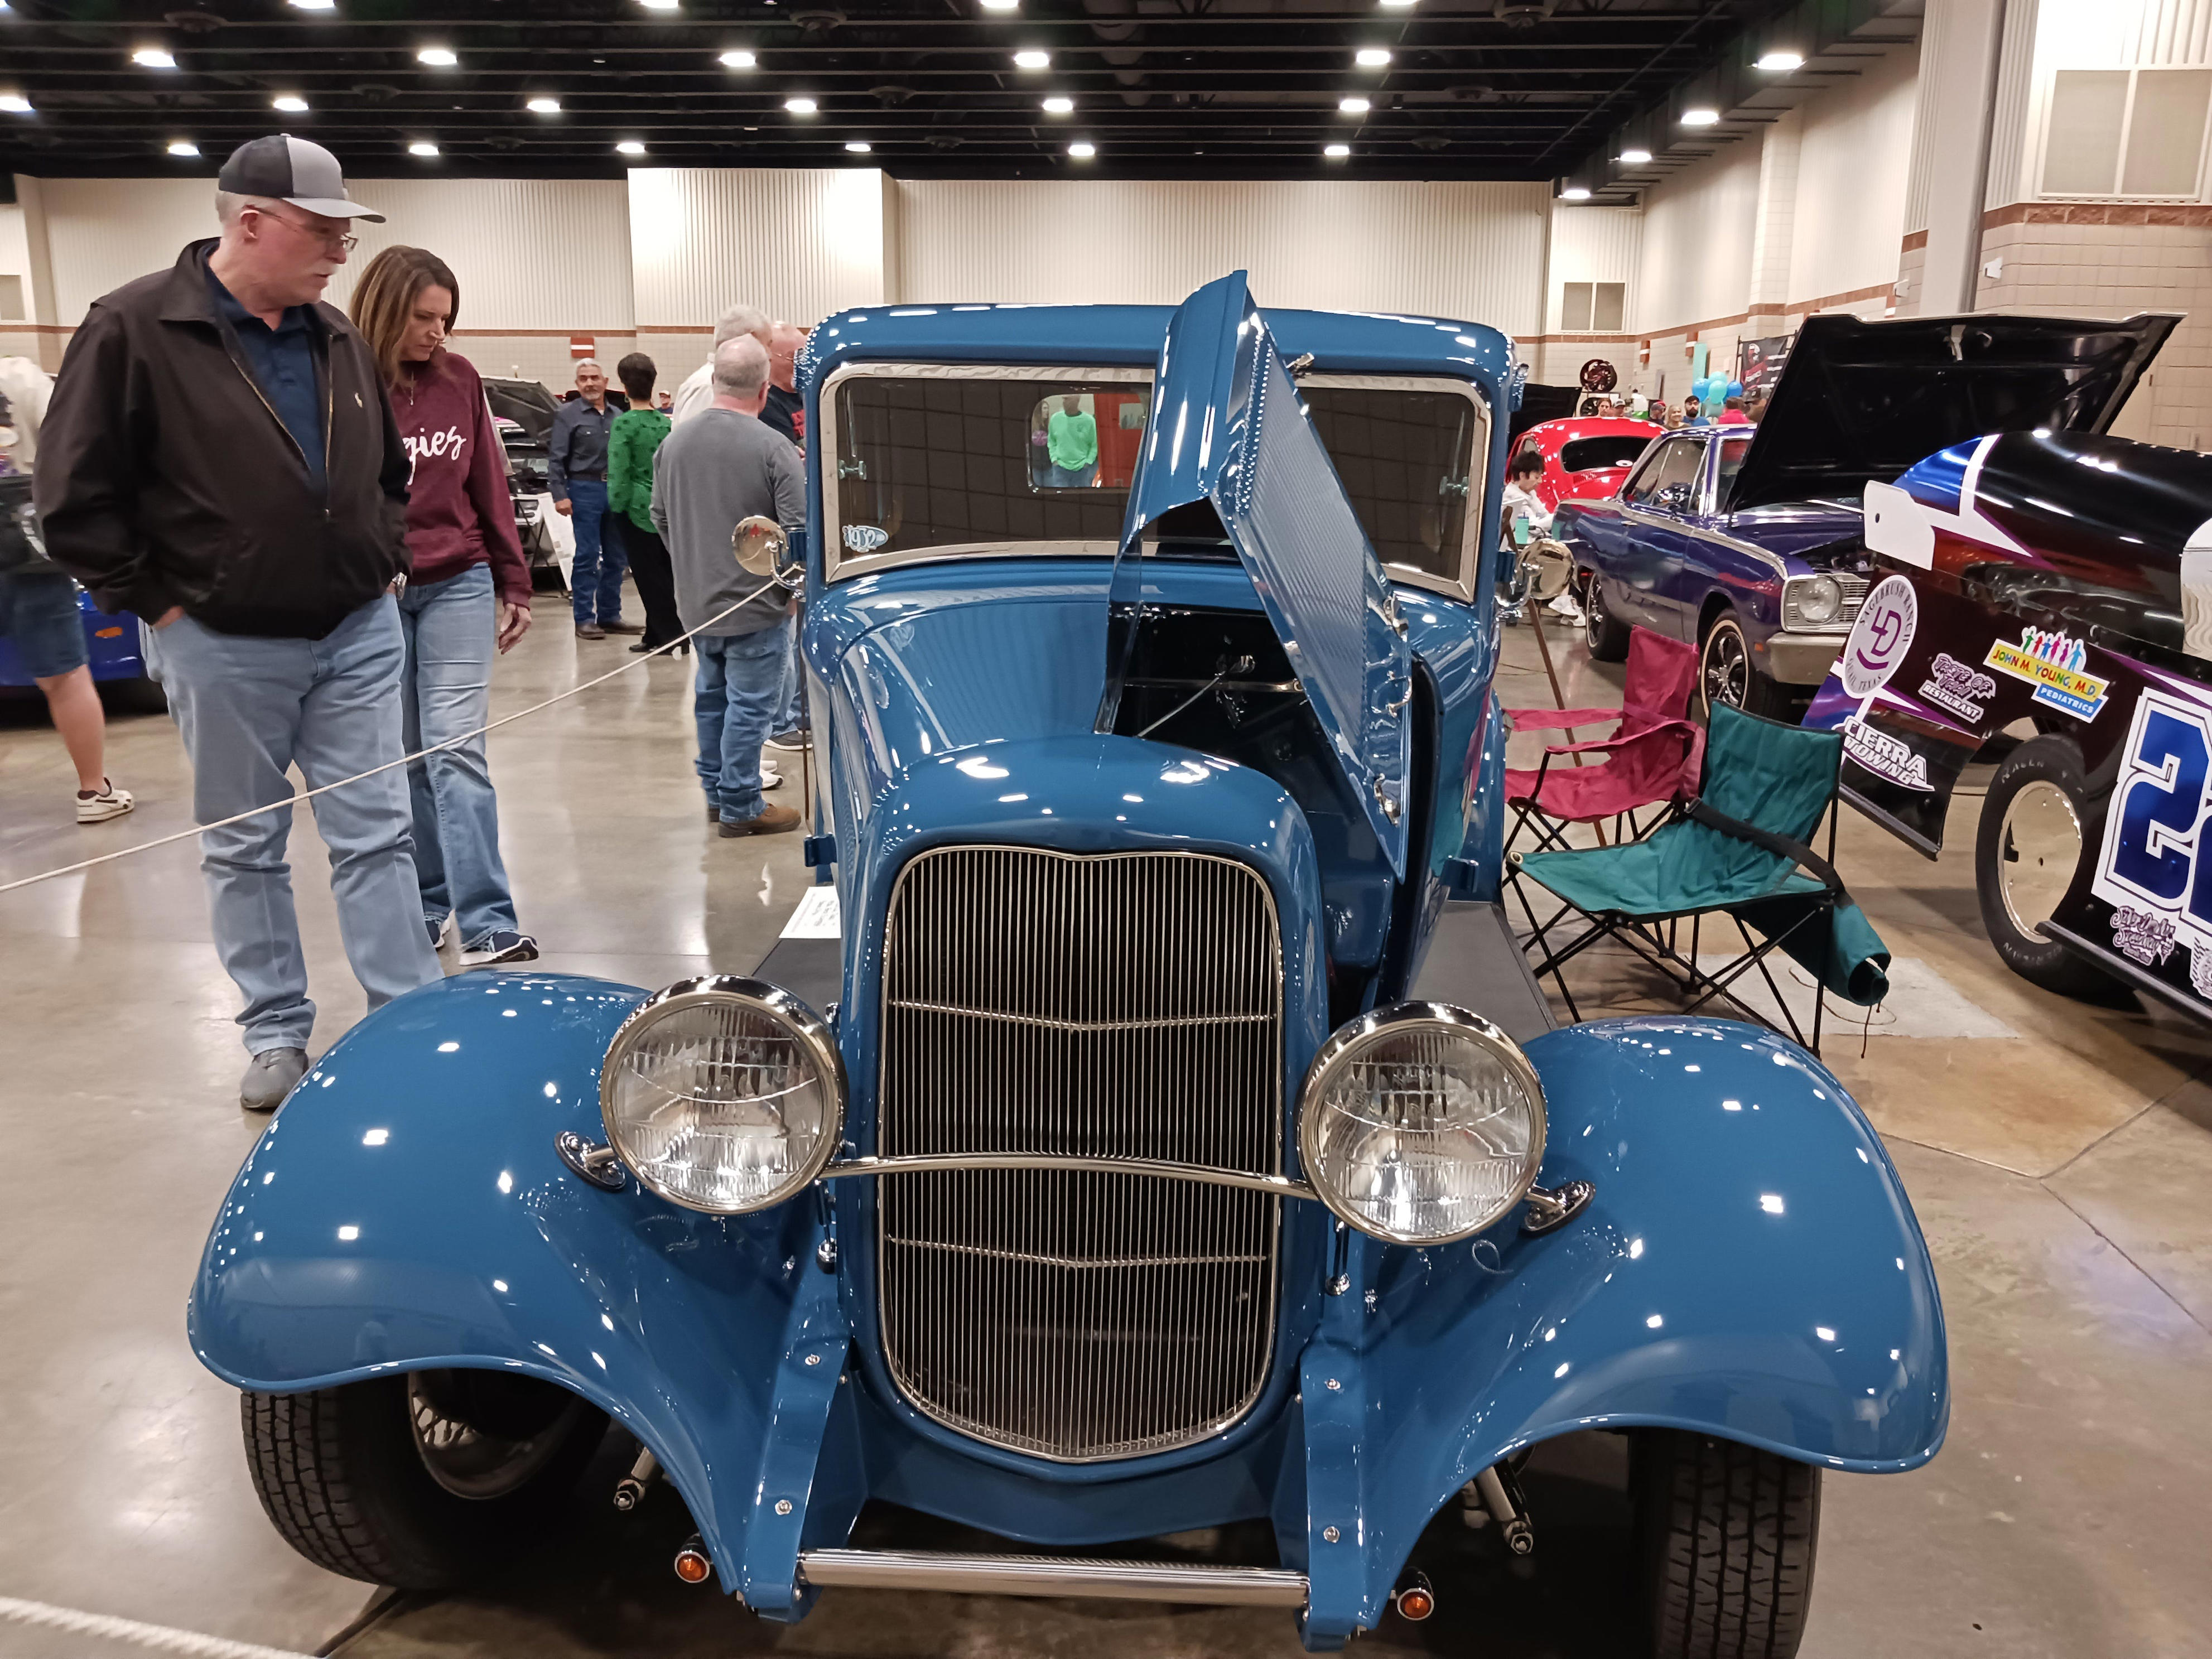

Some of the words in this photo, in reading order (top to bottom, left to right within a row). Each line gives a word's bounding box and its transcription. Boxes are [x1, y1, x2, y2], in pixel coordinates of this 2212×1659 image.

[848, 525, 877, 551] 1932
[1902, 594, 1914, 642] RANCH
[1934, 657, 1972, 681] TASTE
[1971, 677, 1992, 693] OF
[1993, 650, 2020, 667] JOHN
[1922, 684, 1980, 718] RESTAURANT
[2041, 687, 2094, 713] PEDIATRICS
[1844, 718, 1926, 780] CIERRA
[1844, 735, 1915, 785] TOWING
[2106, 700, 2212, 929] 2
